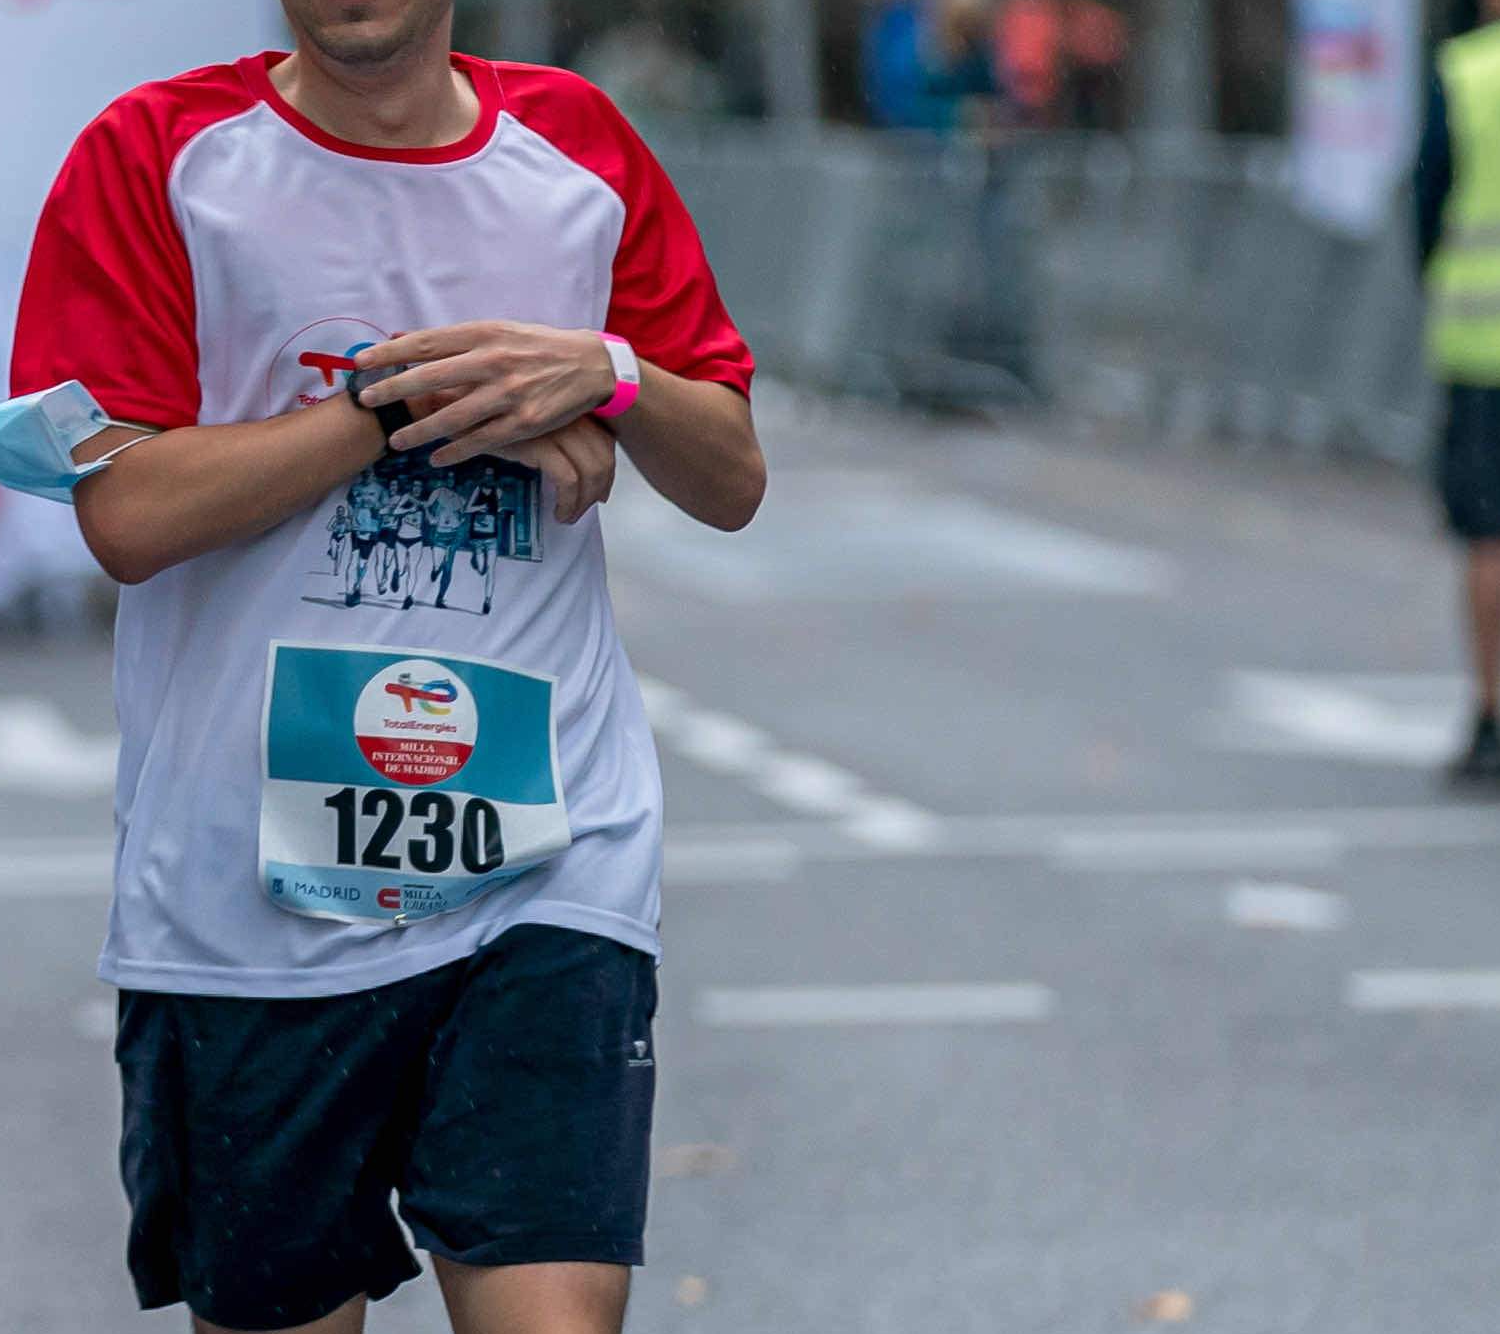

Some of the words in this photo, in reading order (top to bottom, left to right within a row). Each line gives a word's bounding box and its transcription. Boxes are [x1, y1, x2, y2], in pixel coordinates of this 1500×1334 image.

[400, 742, 435, 753] MILLA
[325, 786, 505, 875] 1230
[294, 881, 361, 902] MADRID
[403, 889, 443, 900] MILLA
